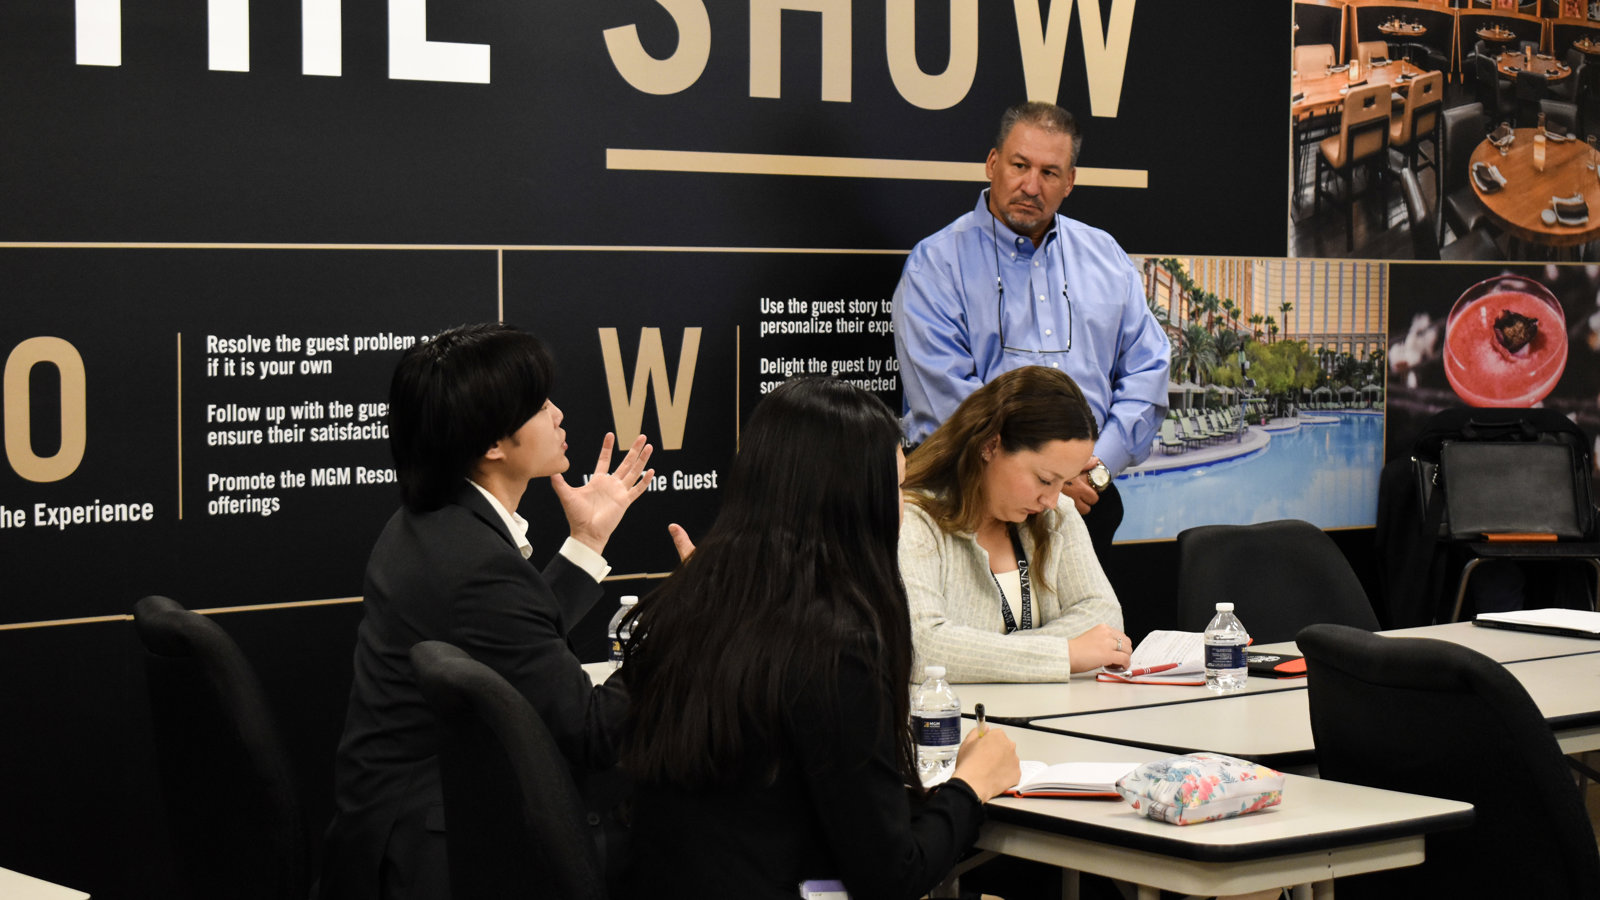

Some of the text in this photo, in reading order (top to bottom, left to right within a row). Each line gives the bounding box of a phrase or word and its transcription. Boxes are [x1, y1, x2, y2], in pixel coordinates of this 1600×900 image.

[761, 298, 892, 317] Use the guest story to
[761, 316, 832, 337] personalize
[836, 317, 864, 333] their
[207, 335, 271, 353] Resolve
[276, 334, 301, 352] the
[306, 334, 349, 356] guest
[354, 332, 416, 355] problem
[208, 357, 332, 379] if it is your own
[761, 357, 804, 377] Delight
[808, 358, 827, 373] the
[832, 358, 864, 376] guest
[869, 357, 881, 375] by
[598, 327, 702, 451] W
[4, 336, 86, 482] O
[208, 404, 261, 422] Follow
[266, 406, 285, 424] up
[291, 401, 324, 419] with
[329, 401, 353, 418] the
[208, 430, 262, 446] ensure
[268, 423, 305, 443] their
[208, 473, 275, 492] Promote
[280, 470, 305, 488] the
[311, 467, 350, 486] MGM
[673, 470, 717, 490] Guest
[35, 499, 153, 530] Experience
[208, 494, 280, 516] offerings
[1018, 560, 1030, 591] UNLV
